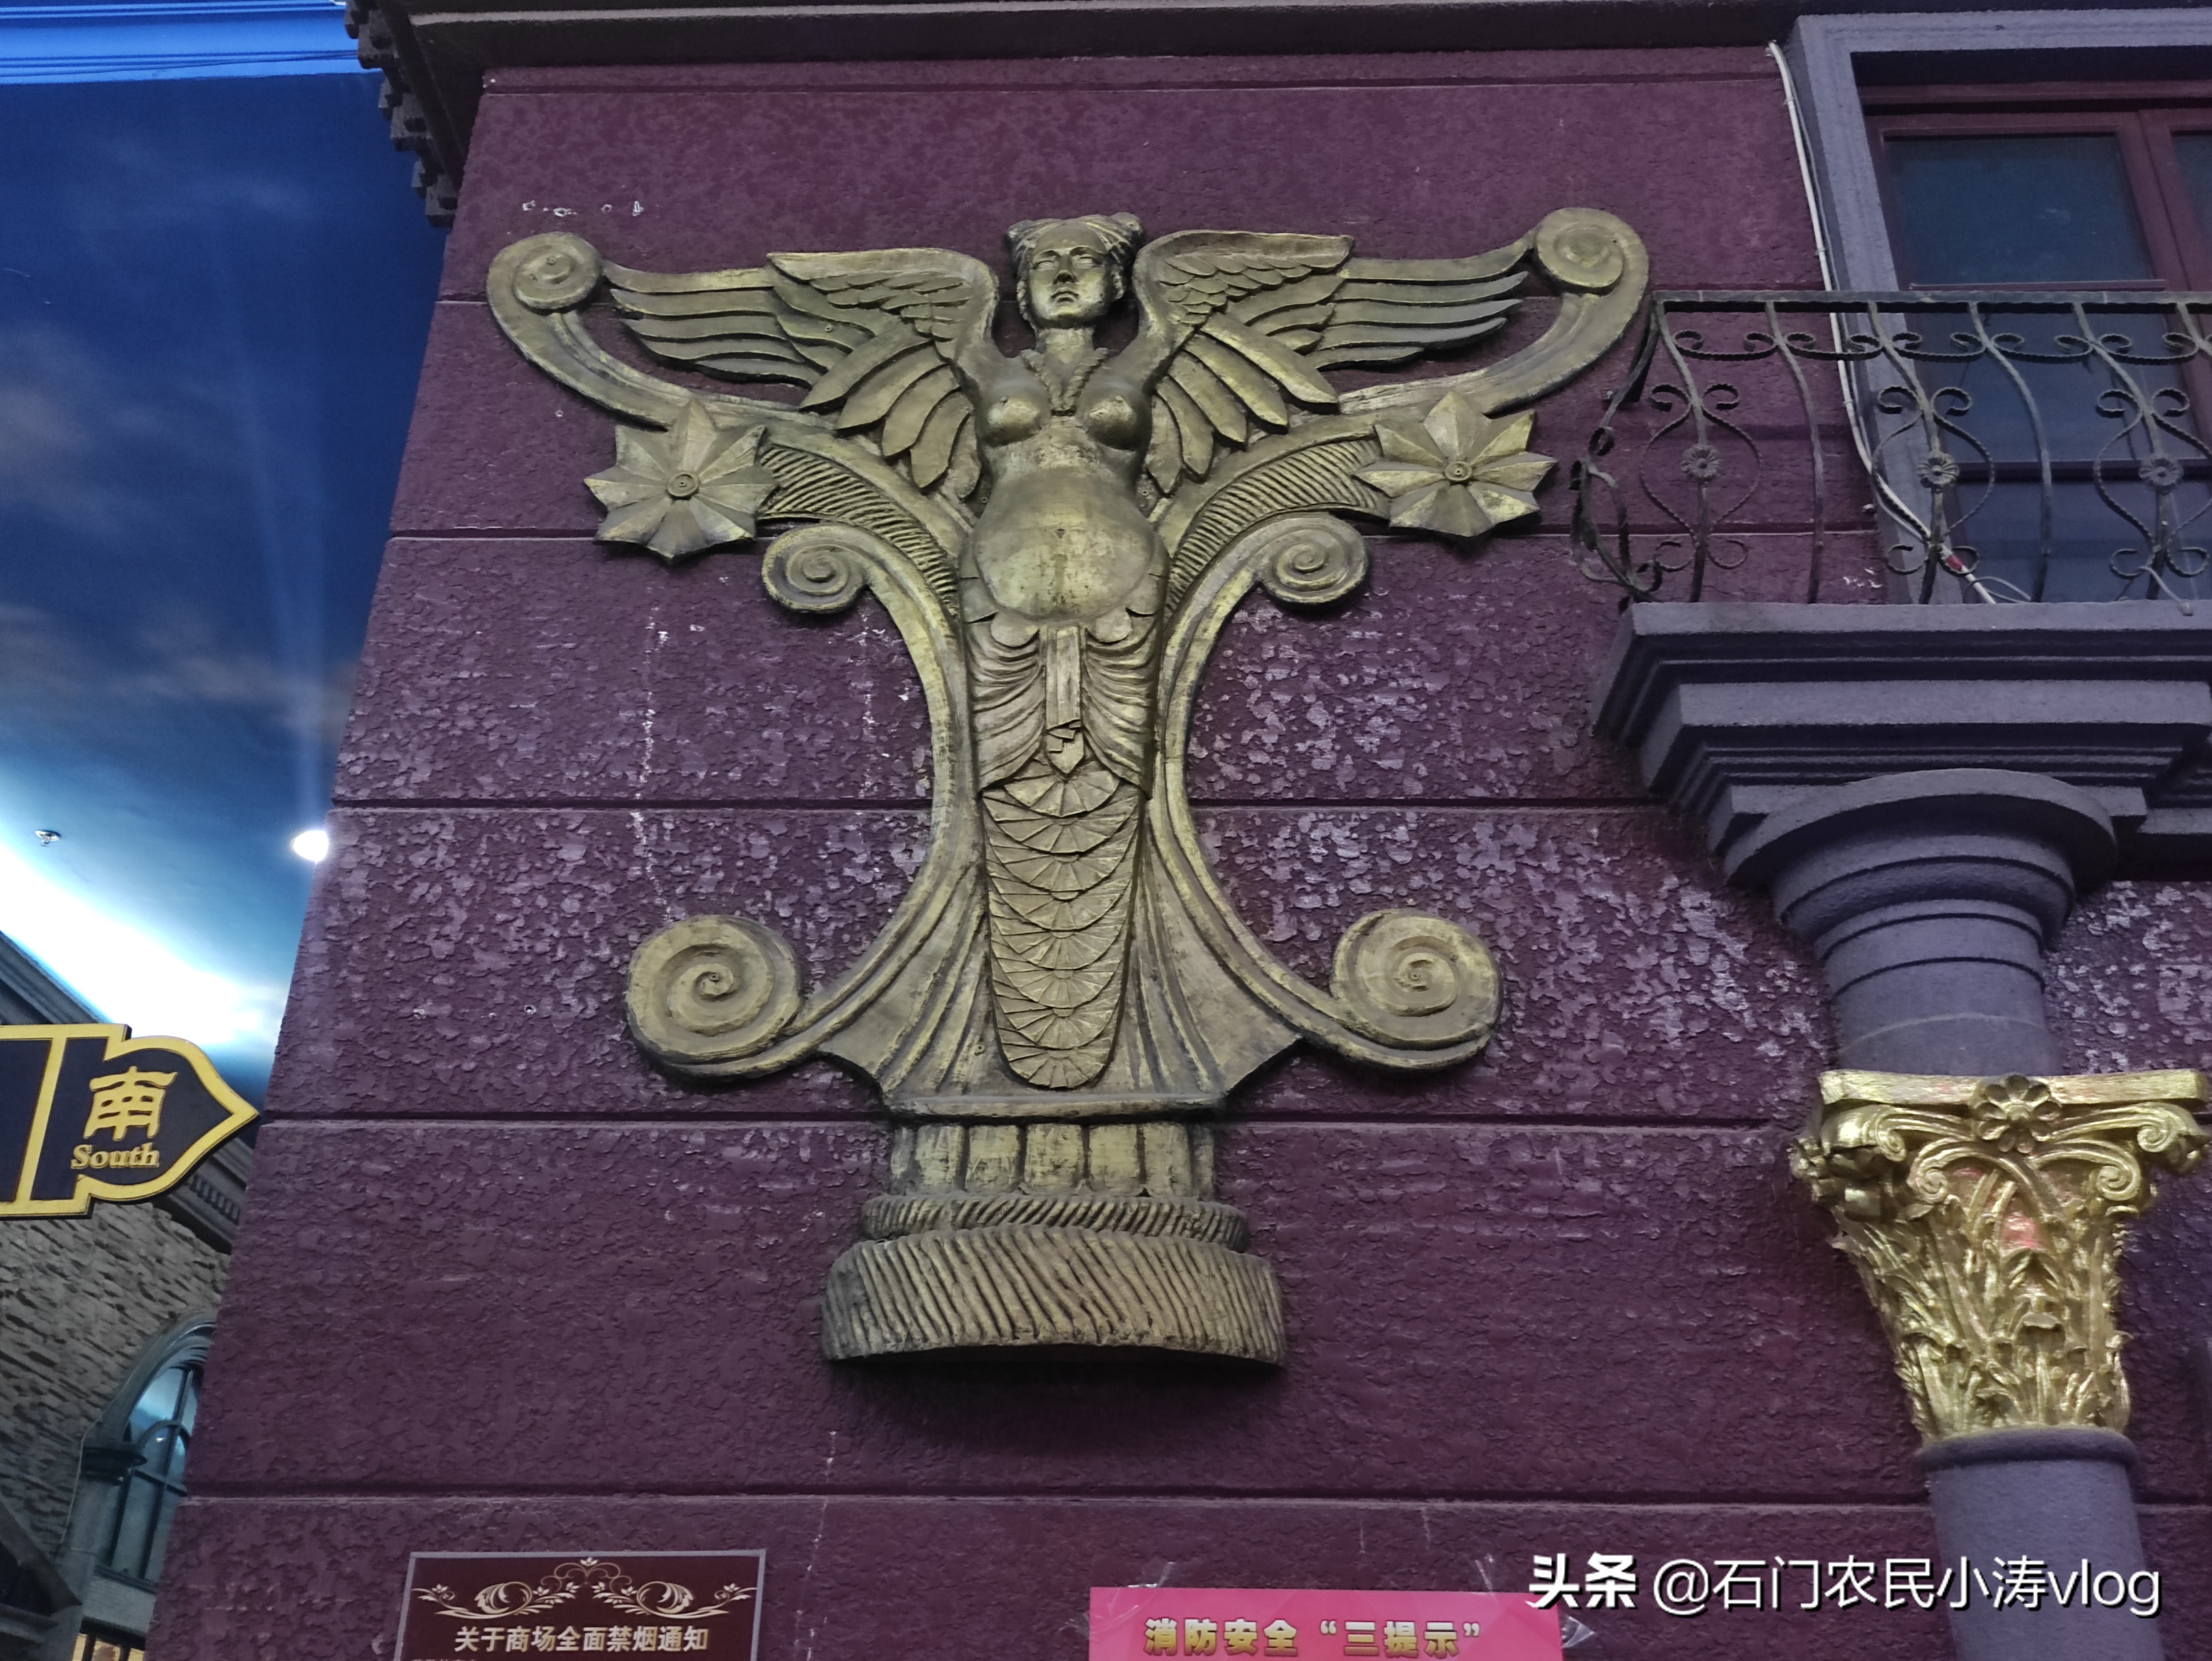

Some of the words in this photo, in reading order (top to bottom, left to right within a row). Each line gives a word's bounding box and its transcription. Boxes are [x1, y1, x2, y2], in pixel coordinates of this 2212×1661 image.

[84, 1066, 178, 1141] 南
[71, 1143, 159, 1168] South
[454, 1626, 708, 1652] 关于商场全面禁烟通知
